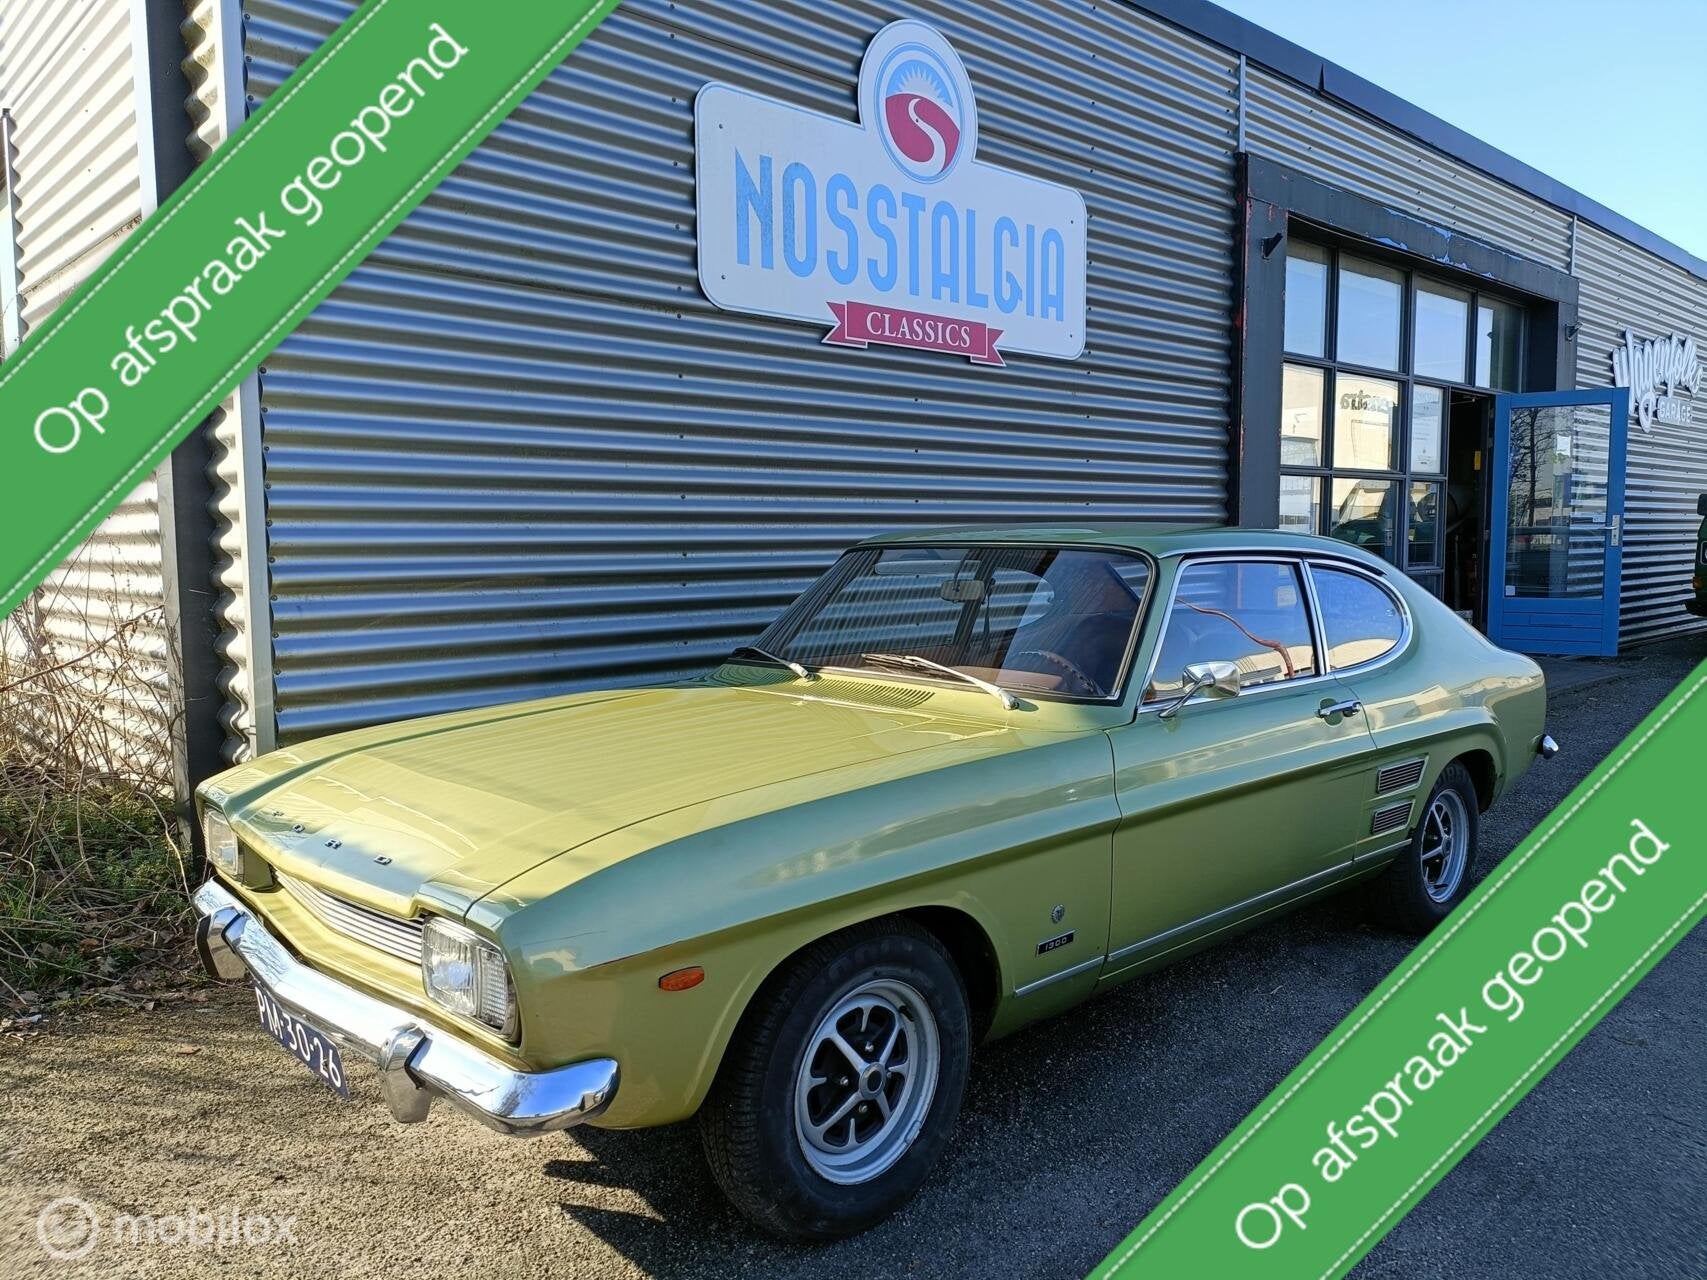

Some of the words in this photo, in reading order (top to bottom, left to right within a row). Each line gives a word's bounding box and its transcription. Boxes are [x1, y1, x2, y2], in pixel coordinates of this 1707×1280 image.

[734, 147, 1065, 323] NOSSTALGIA
[865, 311, 972, 348] CLASSICS
[1659, 400, 1692, 424] GARAGE
[1045, 936, 1068, 951] 1300
